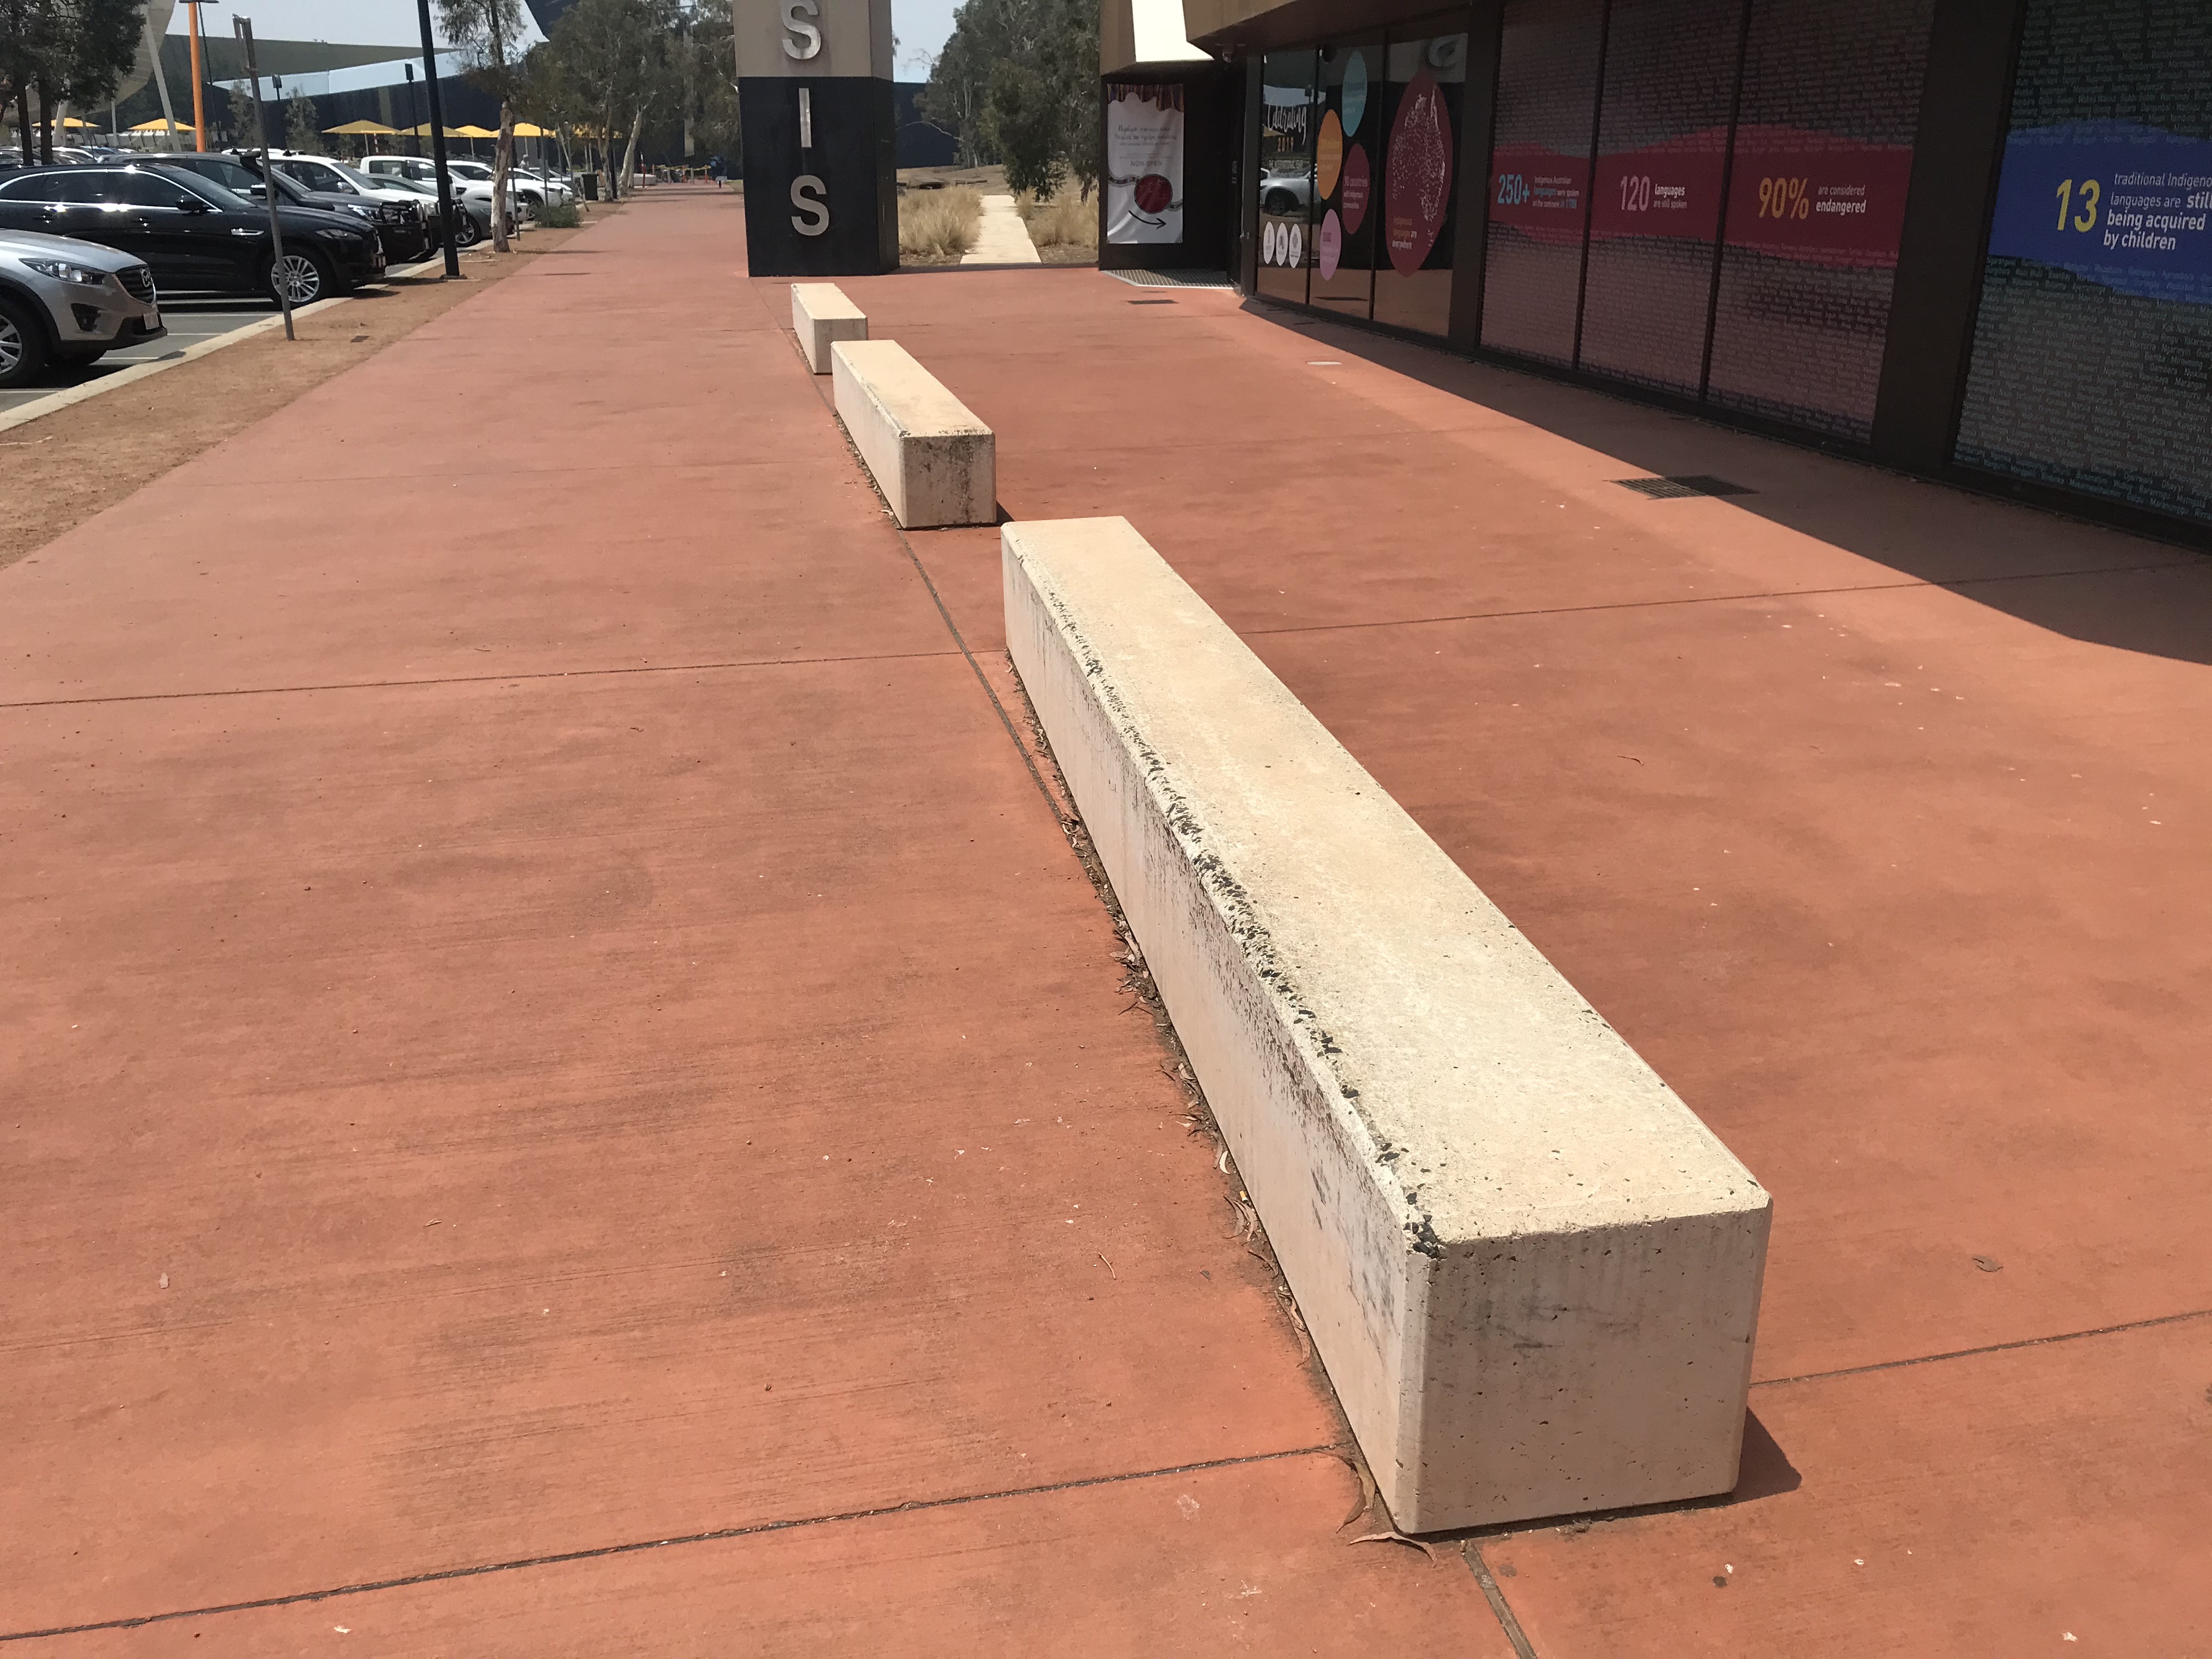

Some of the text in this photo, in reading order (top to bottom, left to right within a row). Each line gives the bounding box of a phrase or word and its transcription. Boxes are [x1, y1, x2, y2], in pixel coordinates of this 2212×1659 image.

[1498, 173, 1530, 205] 250+
[2114, 172, 2165, 186] traditional
[1620, 176, 1651, 211] 120
[1655, 183, 1685, 199] languages
[1759, 177, 1810, 219] 90%
[1818, 184, 1865, 196] are considered
[2111, 191, 2212, 210] languages are still
[1816, 198, 1866, 216] endangered
[2056, 179, 2100, 233] 13
[2107, 208, 2207, 233] being acquired
[2103, 229, 2176, 250] by children
